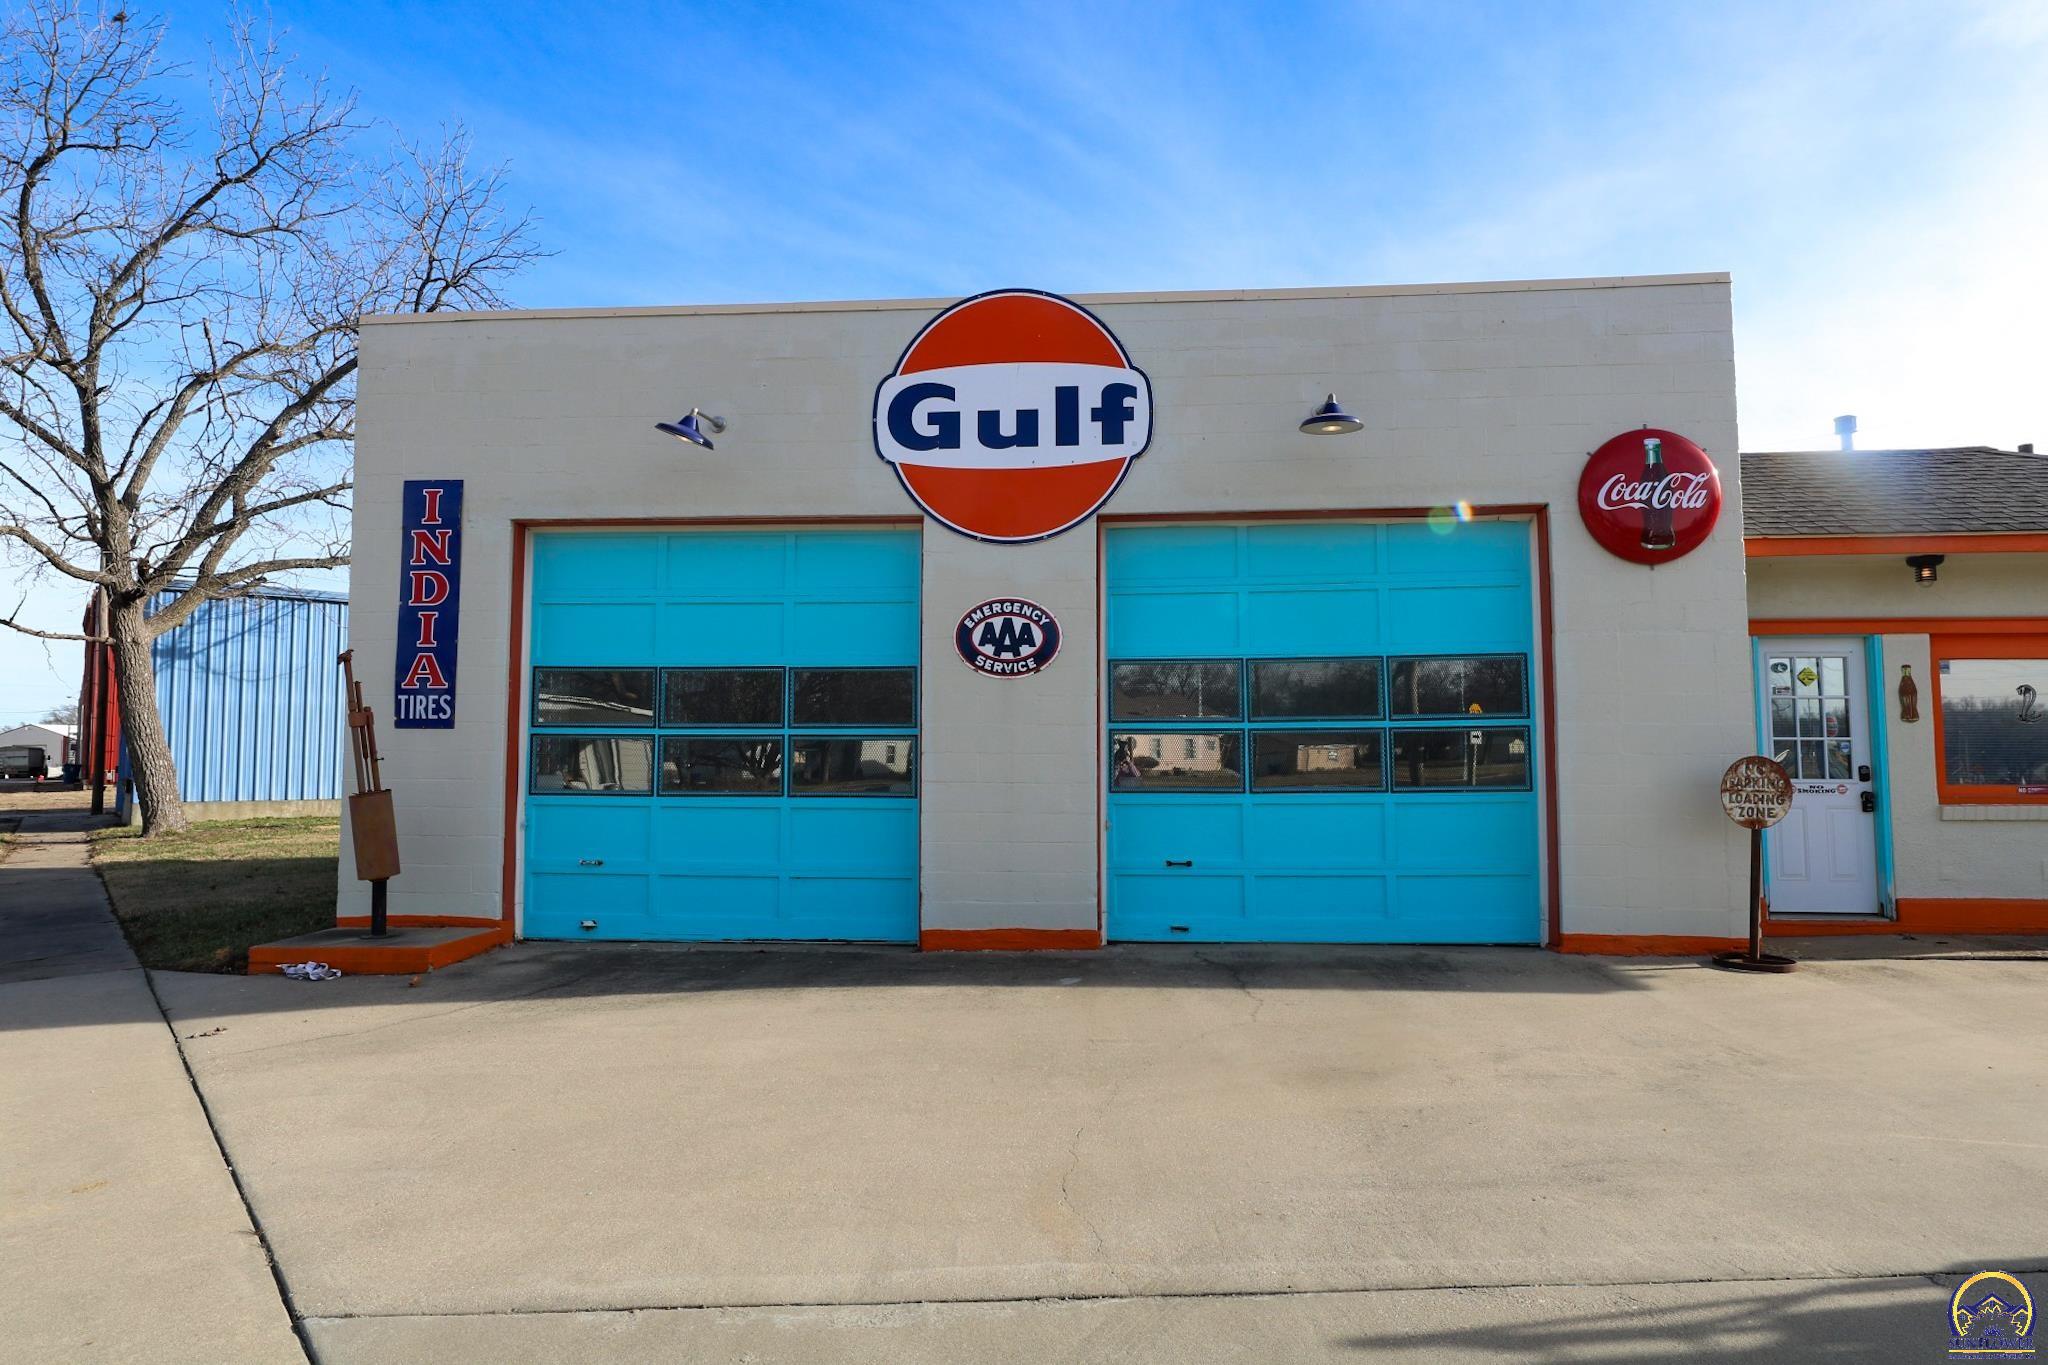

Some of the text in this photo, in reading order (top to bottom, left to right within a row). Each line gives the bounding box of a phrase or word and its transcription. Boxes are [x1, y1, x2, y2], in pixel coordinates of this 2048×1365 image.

[887, 382, 1137, 451] Gulf
[1597, 472, 1710, 511] Coca-Cola
[401, 488, 452, 689] INDIA
[963, 602, 1050, 629] EMERGENCY
[978, 617, 1037, 658] AAA
[975, 655, 1037, 674] SERVICE
[397, 694, 452, 720] TIRES
[1728, 794, 1786, 806] LOADING
[1738, 806, 1777, 818] ZONE
